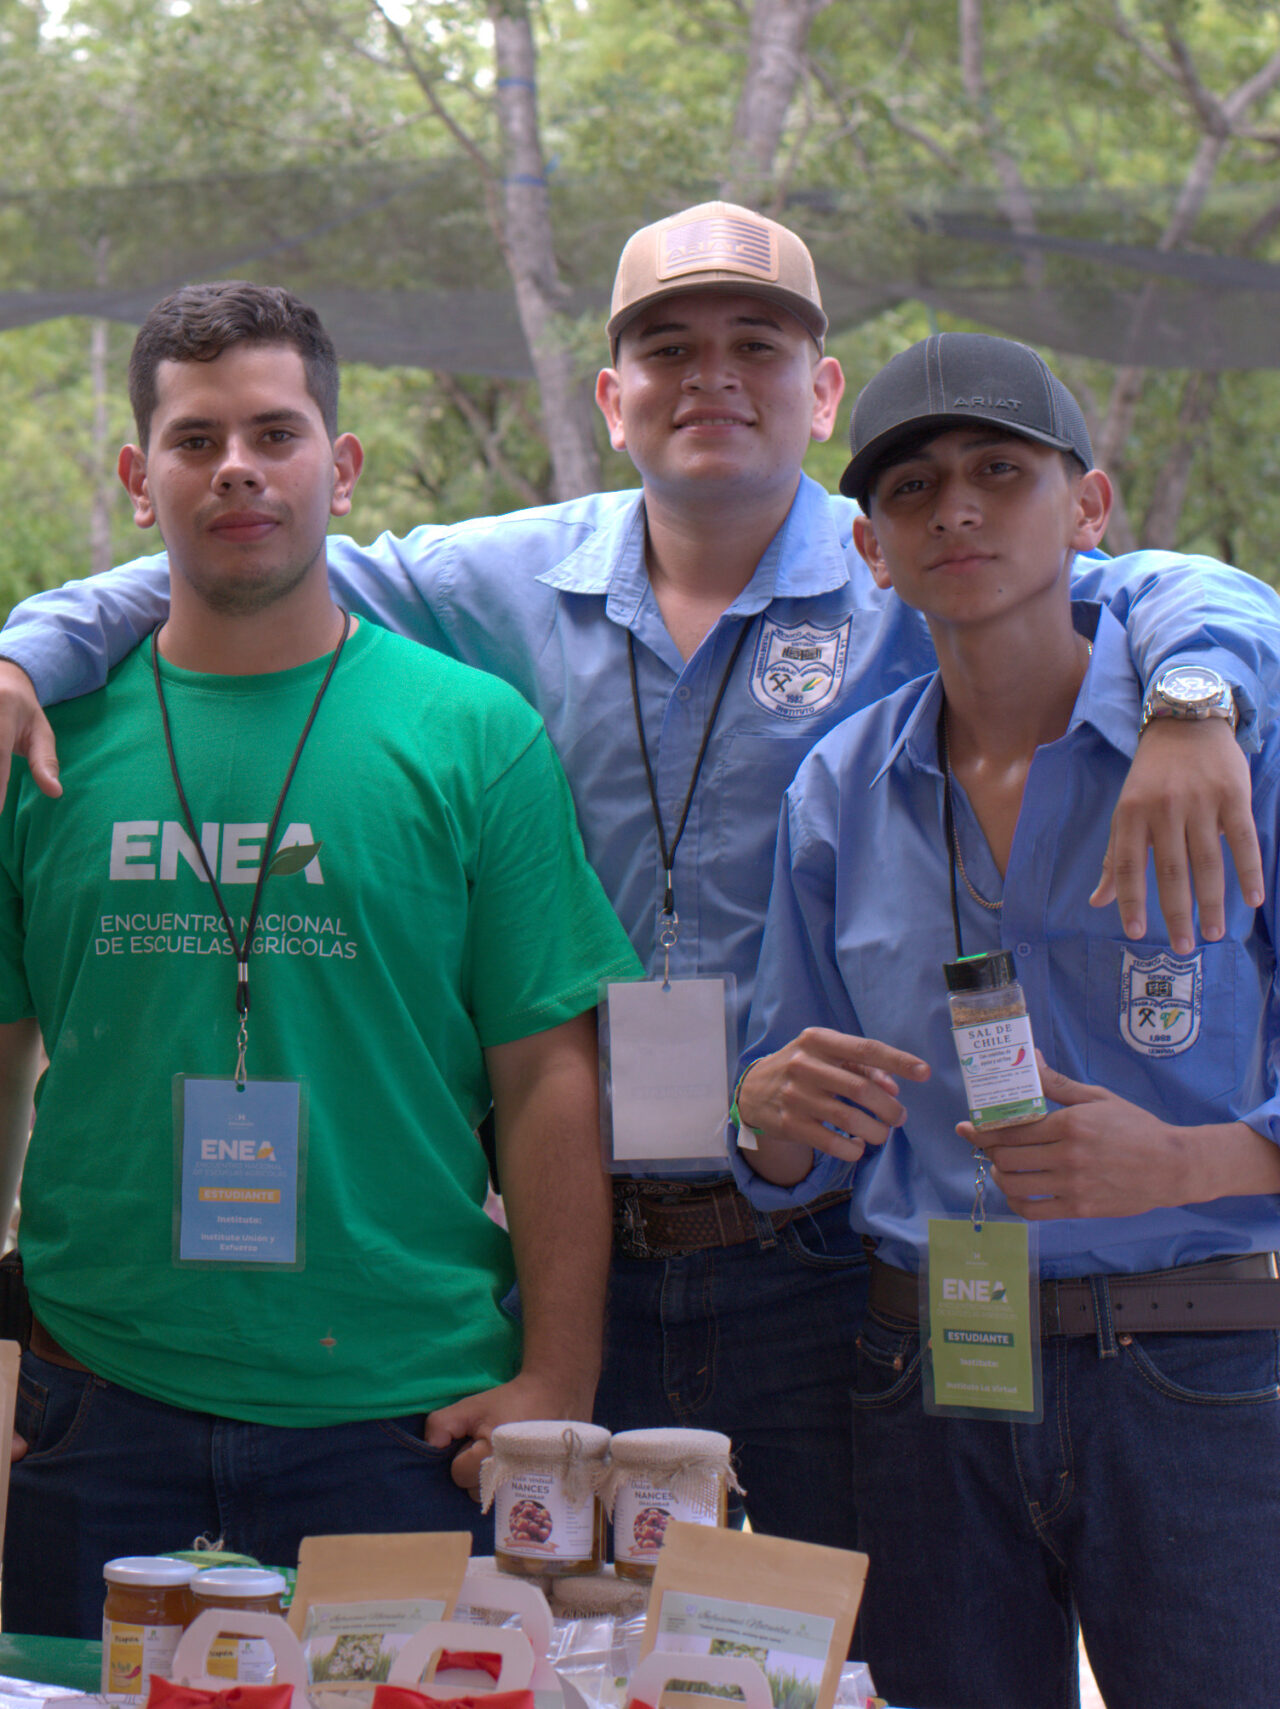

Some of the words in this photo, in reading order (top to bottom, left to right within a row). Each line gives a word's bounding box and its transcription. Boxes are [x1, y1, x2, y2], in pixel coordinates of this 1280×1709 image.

[952, 396, 1022, 411] ARIAT
[109, 820, 325, 885] ENEA
[100, 913, 234, 933] ENCUENTRO
[240, 913, 348, 937] NACIONAL
[95, 937, 124, 955] DE
[131, 935, 234, 955] ESCUELAS
[243, 933, 357, 959] AGRÍCOLAS
[969, 1028, 992, 1040] SAL
[996, 1024, 1012, 1035] DE
[973, 1035, 1011, 1049] CHILE
[201, 1139, 277, 1161] ENEA
[204, 1189, 274, 1200] ESTUDIANTE
[942, 1278, 1008, 1304] ENEA
[948, 1331, 1009, 1344] ESTUDIANTE
[511, 1482, 550, 1494] NANCES
